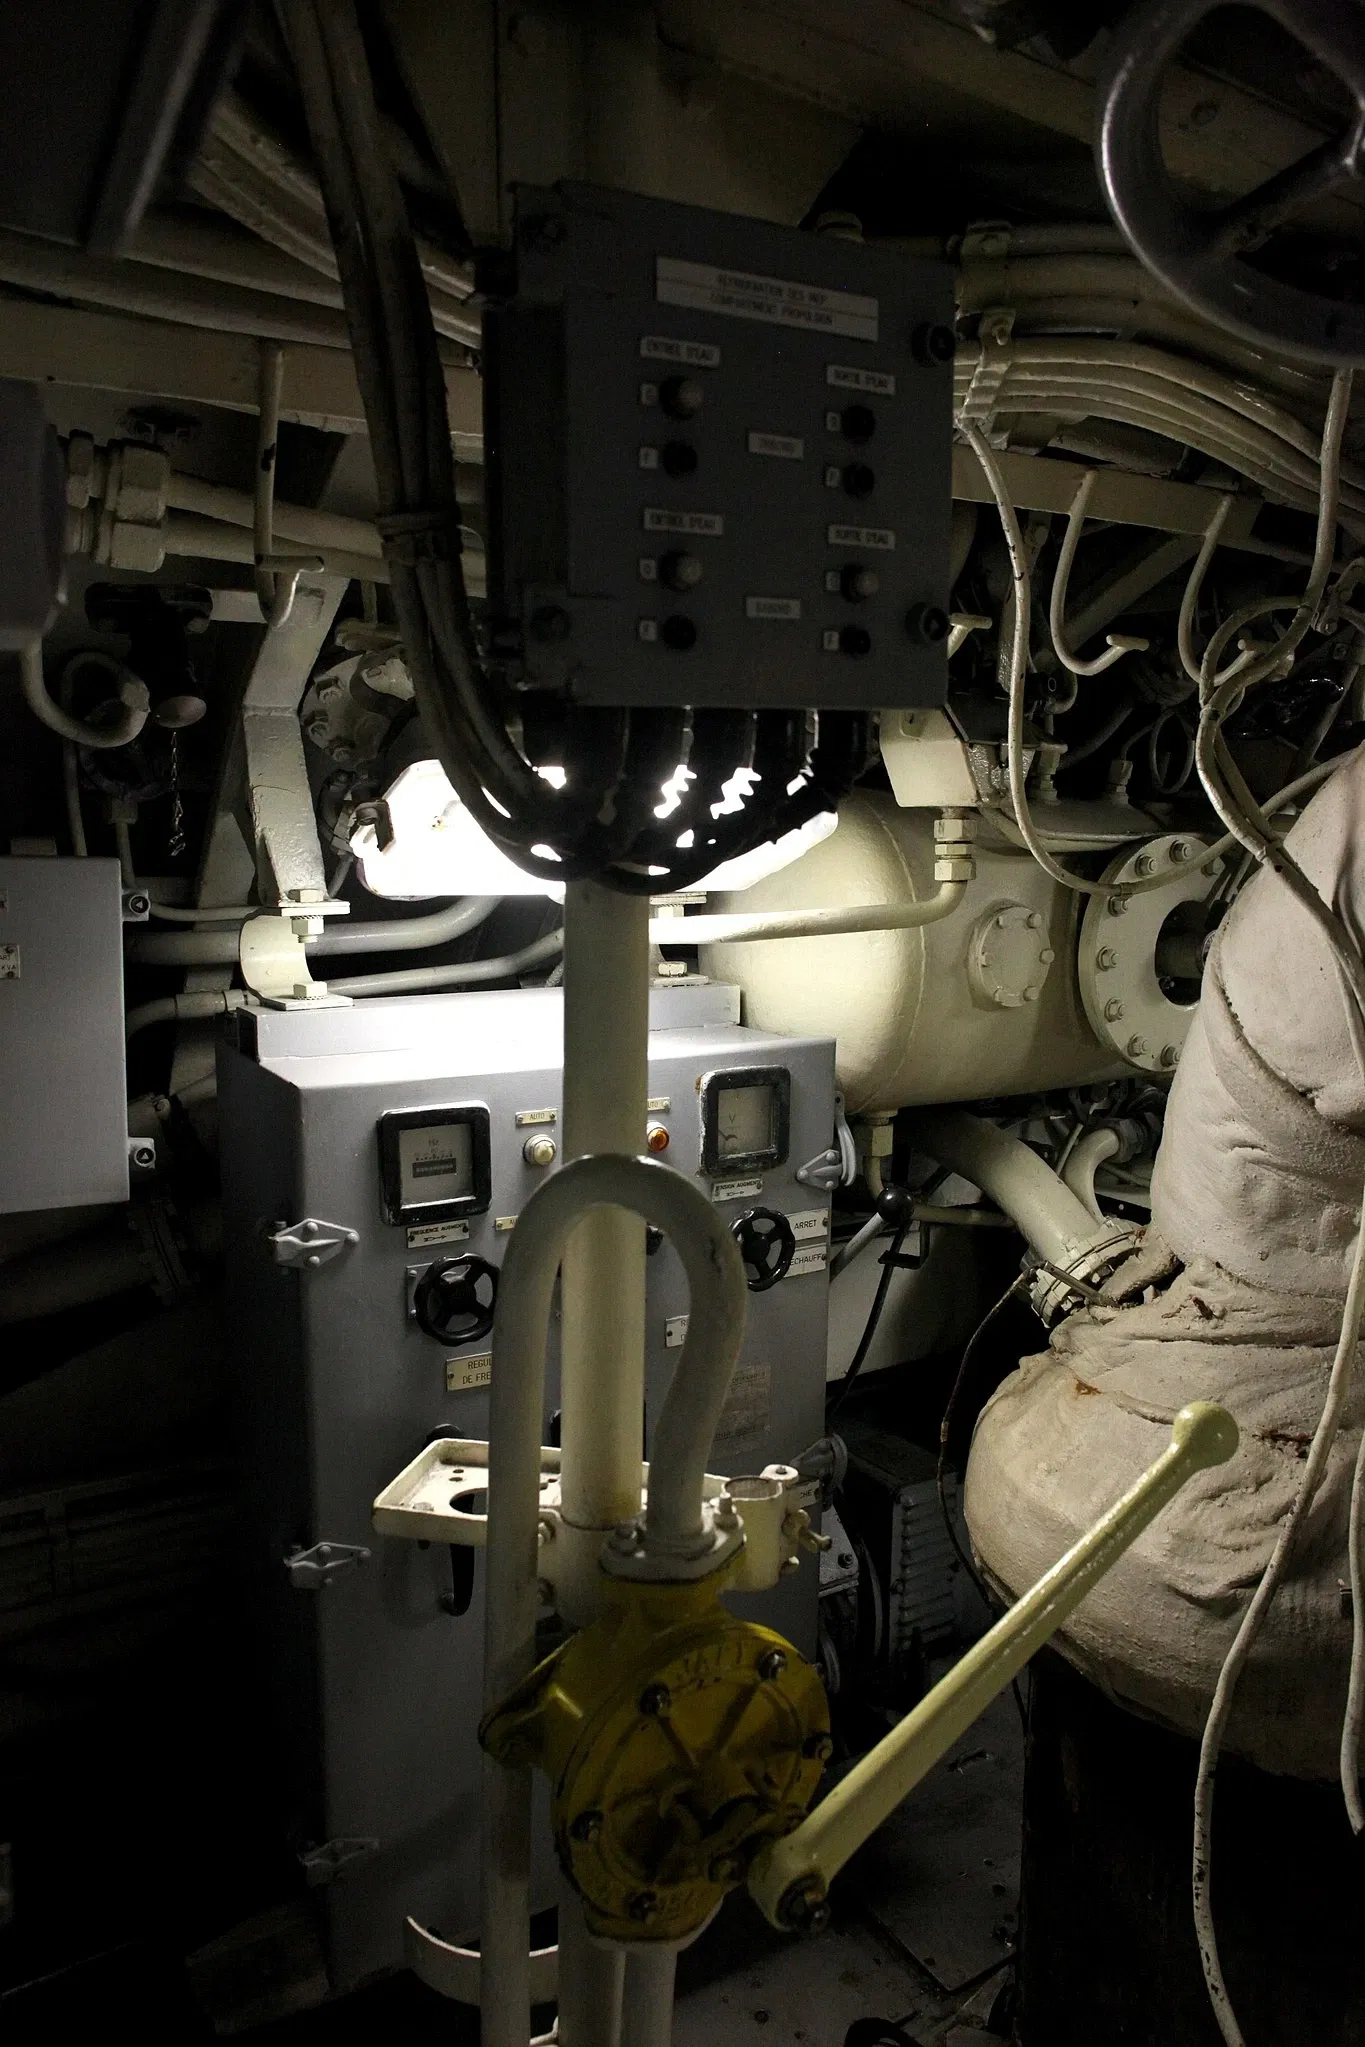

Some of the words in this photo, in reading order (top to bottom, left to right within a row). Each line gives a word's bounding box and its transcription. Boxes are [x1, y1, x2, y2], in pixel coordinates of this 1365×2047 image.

[529, 1112, 546, 1121] AUTO
[728, 1112, 737, 1124] V
[794, 1219, 817, 1231] ARRET
[462, 1374, 473, 1385] DE
